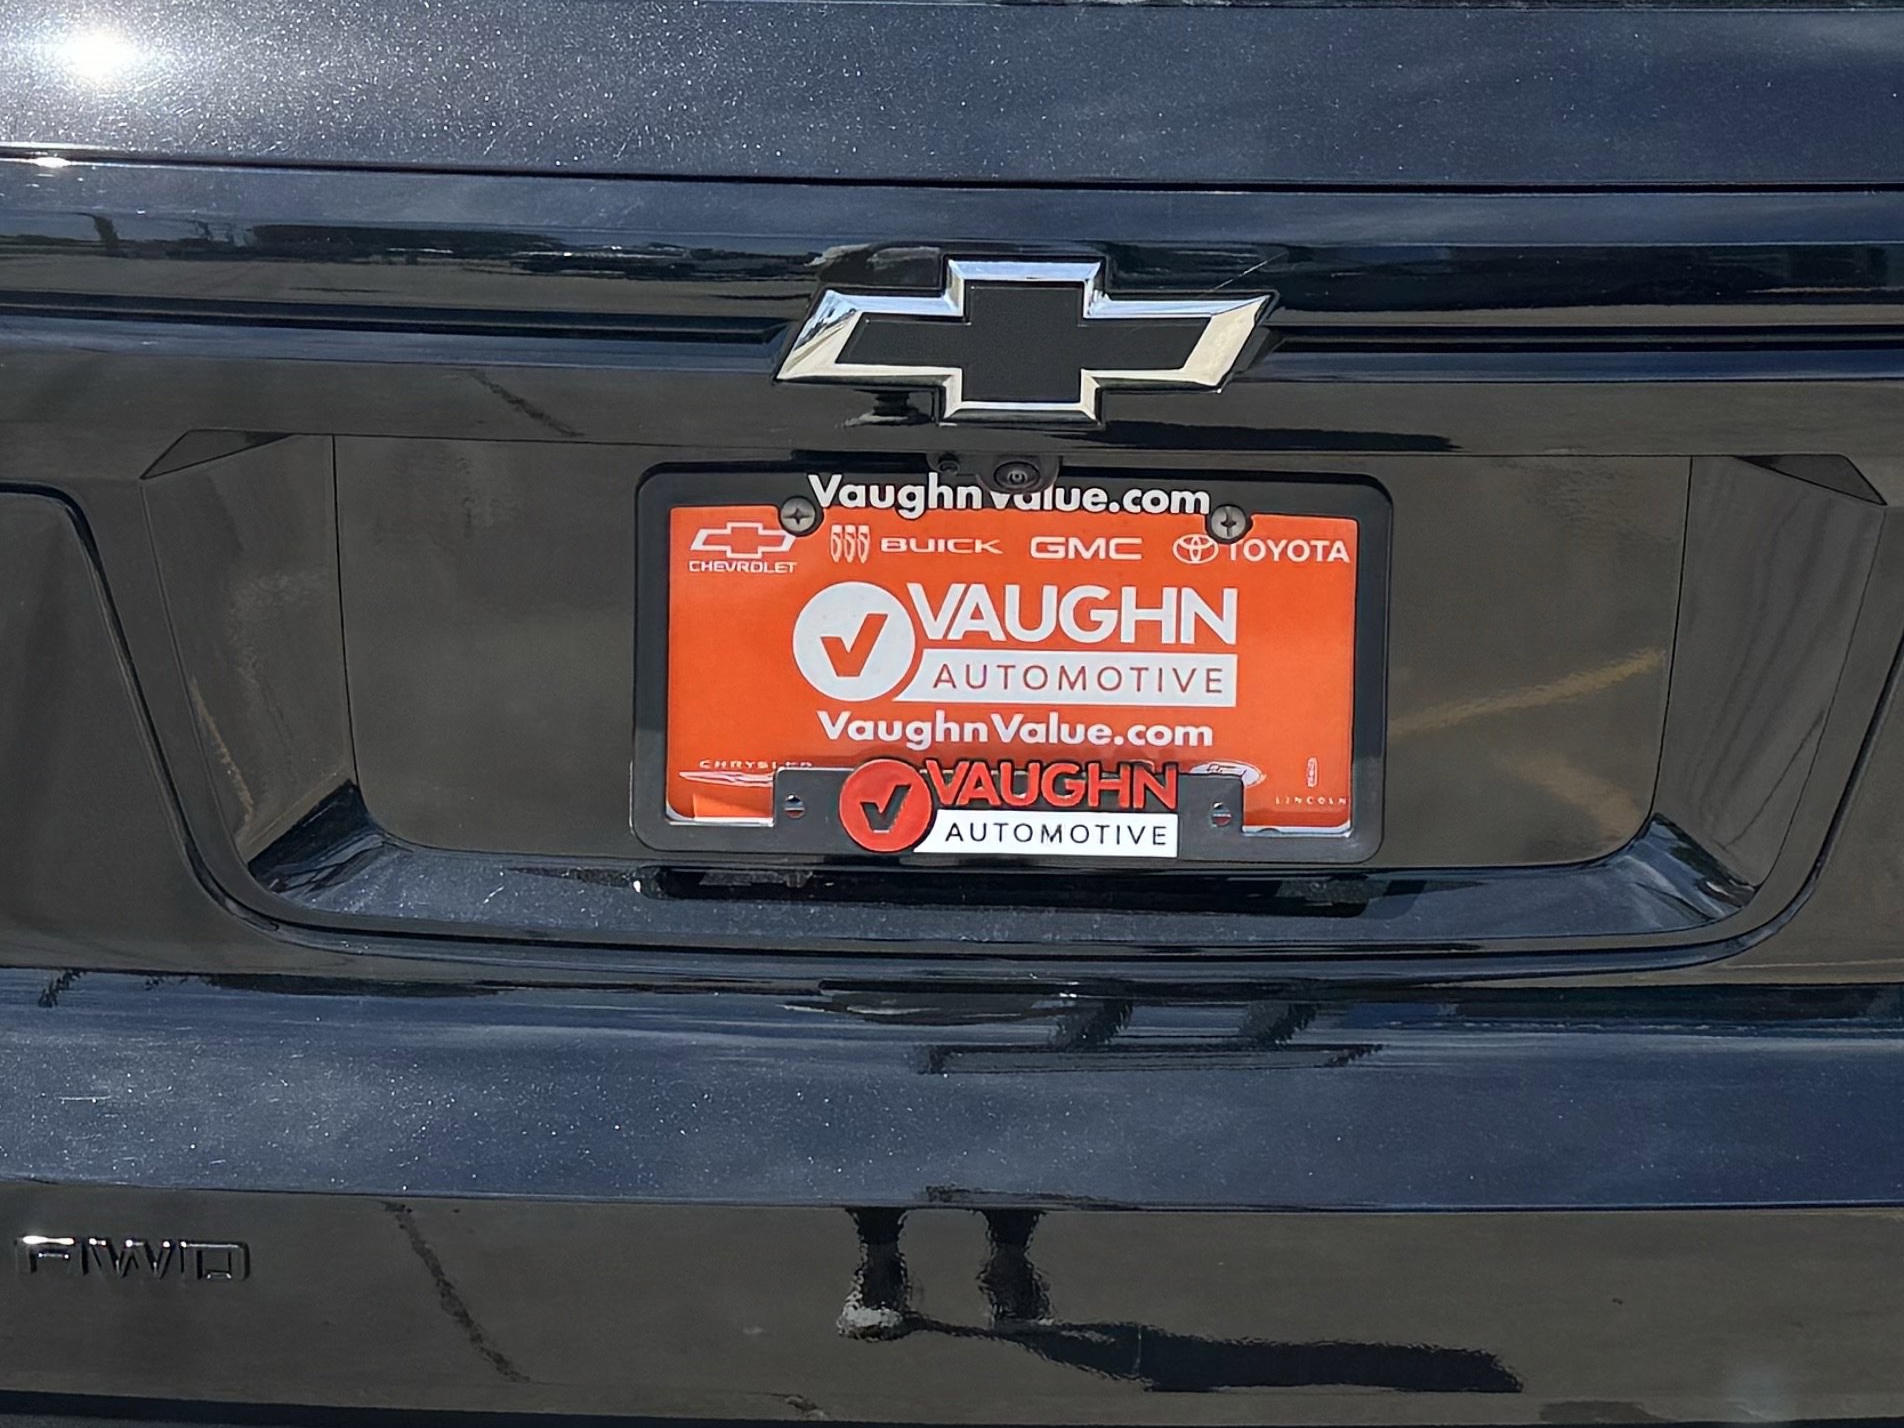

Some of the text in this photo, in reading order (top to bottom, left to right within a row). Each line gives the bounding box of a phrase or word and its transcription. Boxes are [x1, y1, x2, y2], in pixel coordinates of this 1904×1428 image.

[880, 535, 1004, 555] BUICK
[1029, 535, 1143, 560] GMC
[1224, 537, 1351, 563] TOYOTA
[688, 560, 798, 574] CHEVROLET
[906, 581, 1239, 646] VAUGHN
[933, 663, 1225, 695] AUTOMOTIVE
[816, 709, 1215, 751] VaughnValue.com
[924, 758, 1180, 812] VAUGHN
[945, 820, 1168, 847] AUTOMOTIVE
[14, 1231, 251, 1283] AWD
